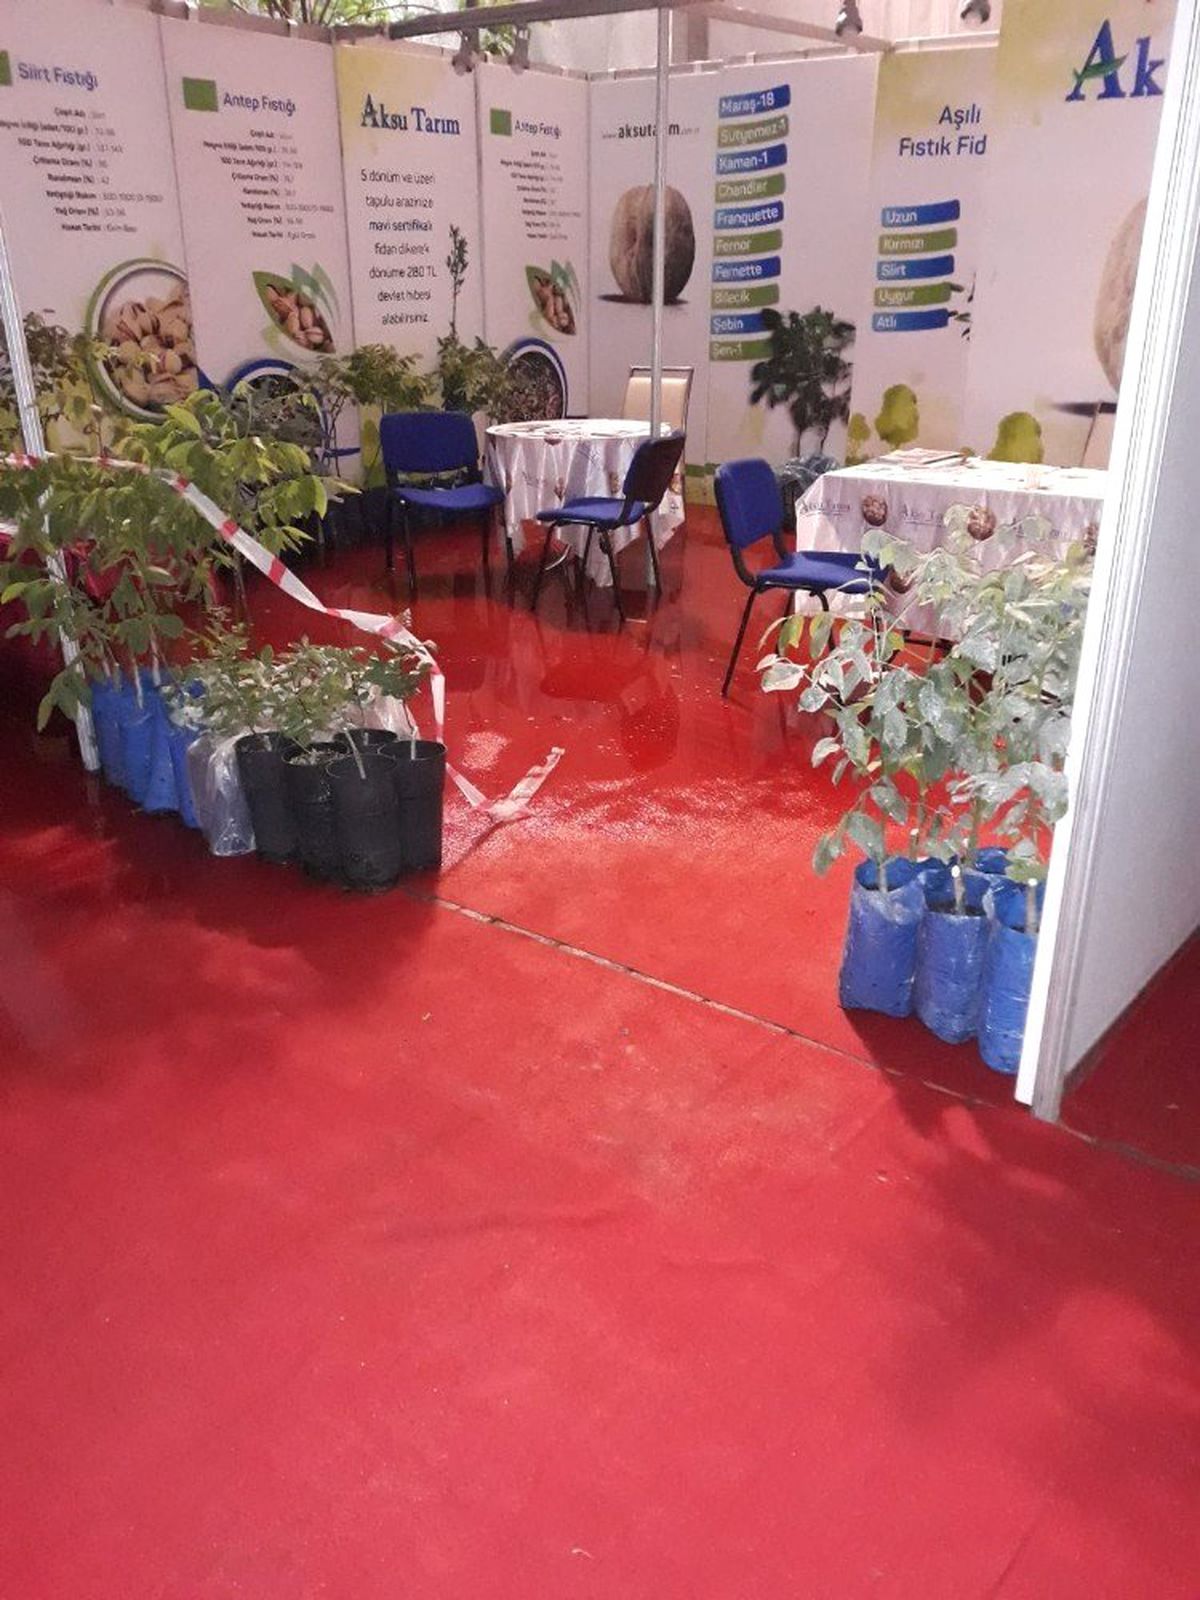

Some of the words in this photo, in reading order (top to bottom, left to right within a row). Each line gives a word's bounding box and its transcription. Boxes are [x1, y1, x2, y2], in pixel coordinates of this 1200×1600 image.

[18, 62, 50, 83] Siirt
[53, 67, 98, 91] Fıstığı
[223, 92, 260, 112] Antep
[262, 95, 296, 116] Fıstığı
[720, 91, 775, 114] Maraş-18
[361, 93, 408, 131] Aksu
[411, 107, 460, 135] Tarım
[938, 103, 982, 130] Aşılı
[898, 137, 951, 157] Fıstık
[718, 151, 768, 170] Kaman-1
[401, 173, 413, 183] ve
[365, 195, 394, 208] tapulu
[716, 206, 779, 228] Franquette
[886, 208, 918, 223] Uzun
[369, 220, 391, 231] mavi
[715, 238, 751, 252] Fernor
[407, 266, 425, 278] 280
[426, 266, 437, 278] TL
[377, 289, 405, 302] devlet
[713, 316, 745, 335] Şebin
